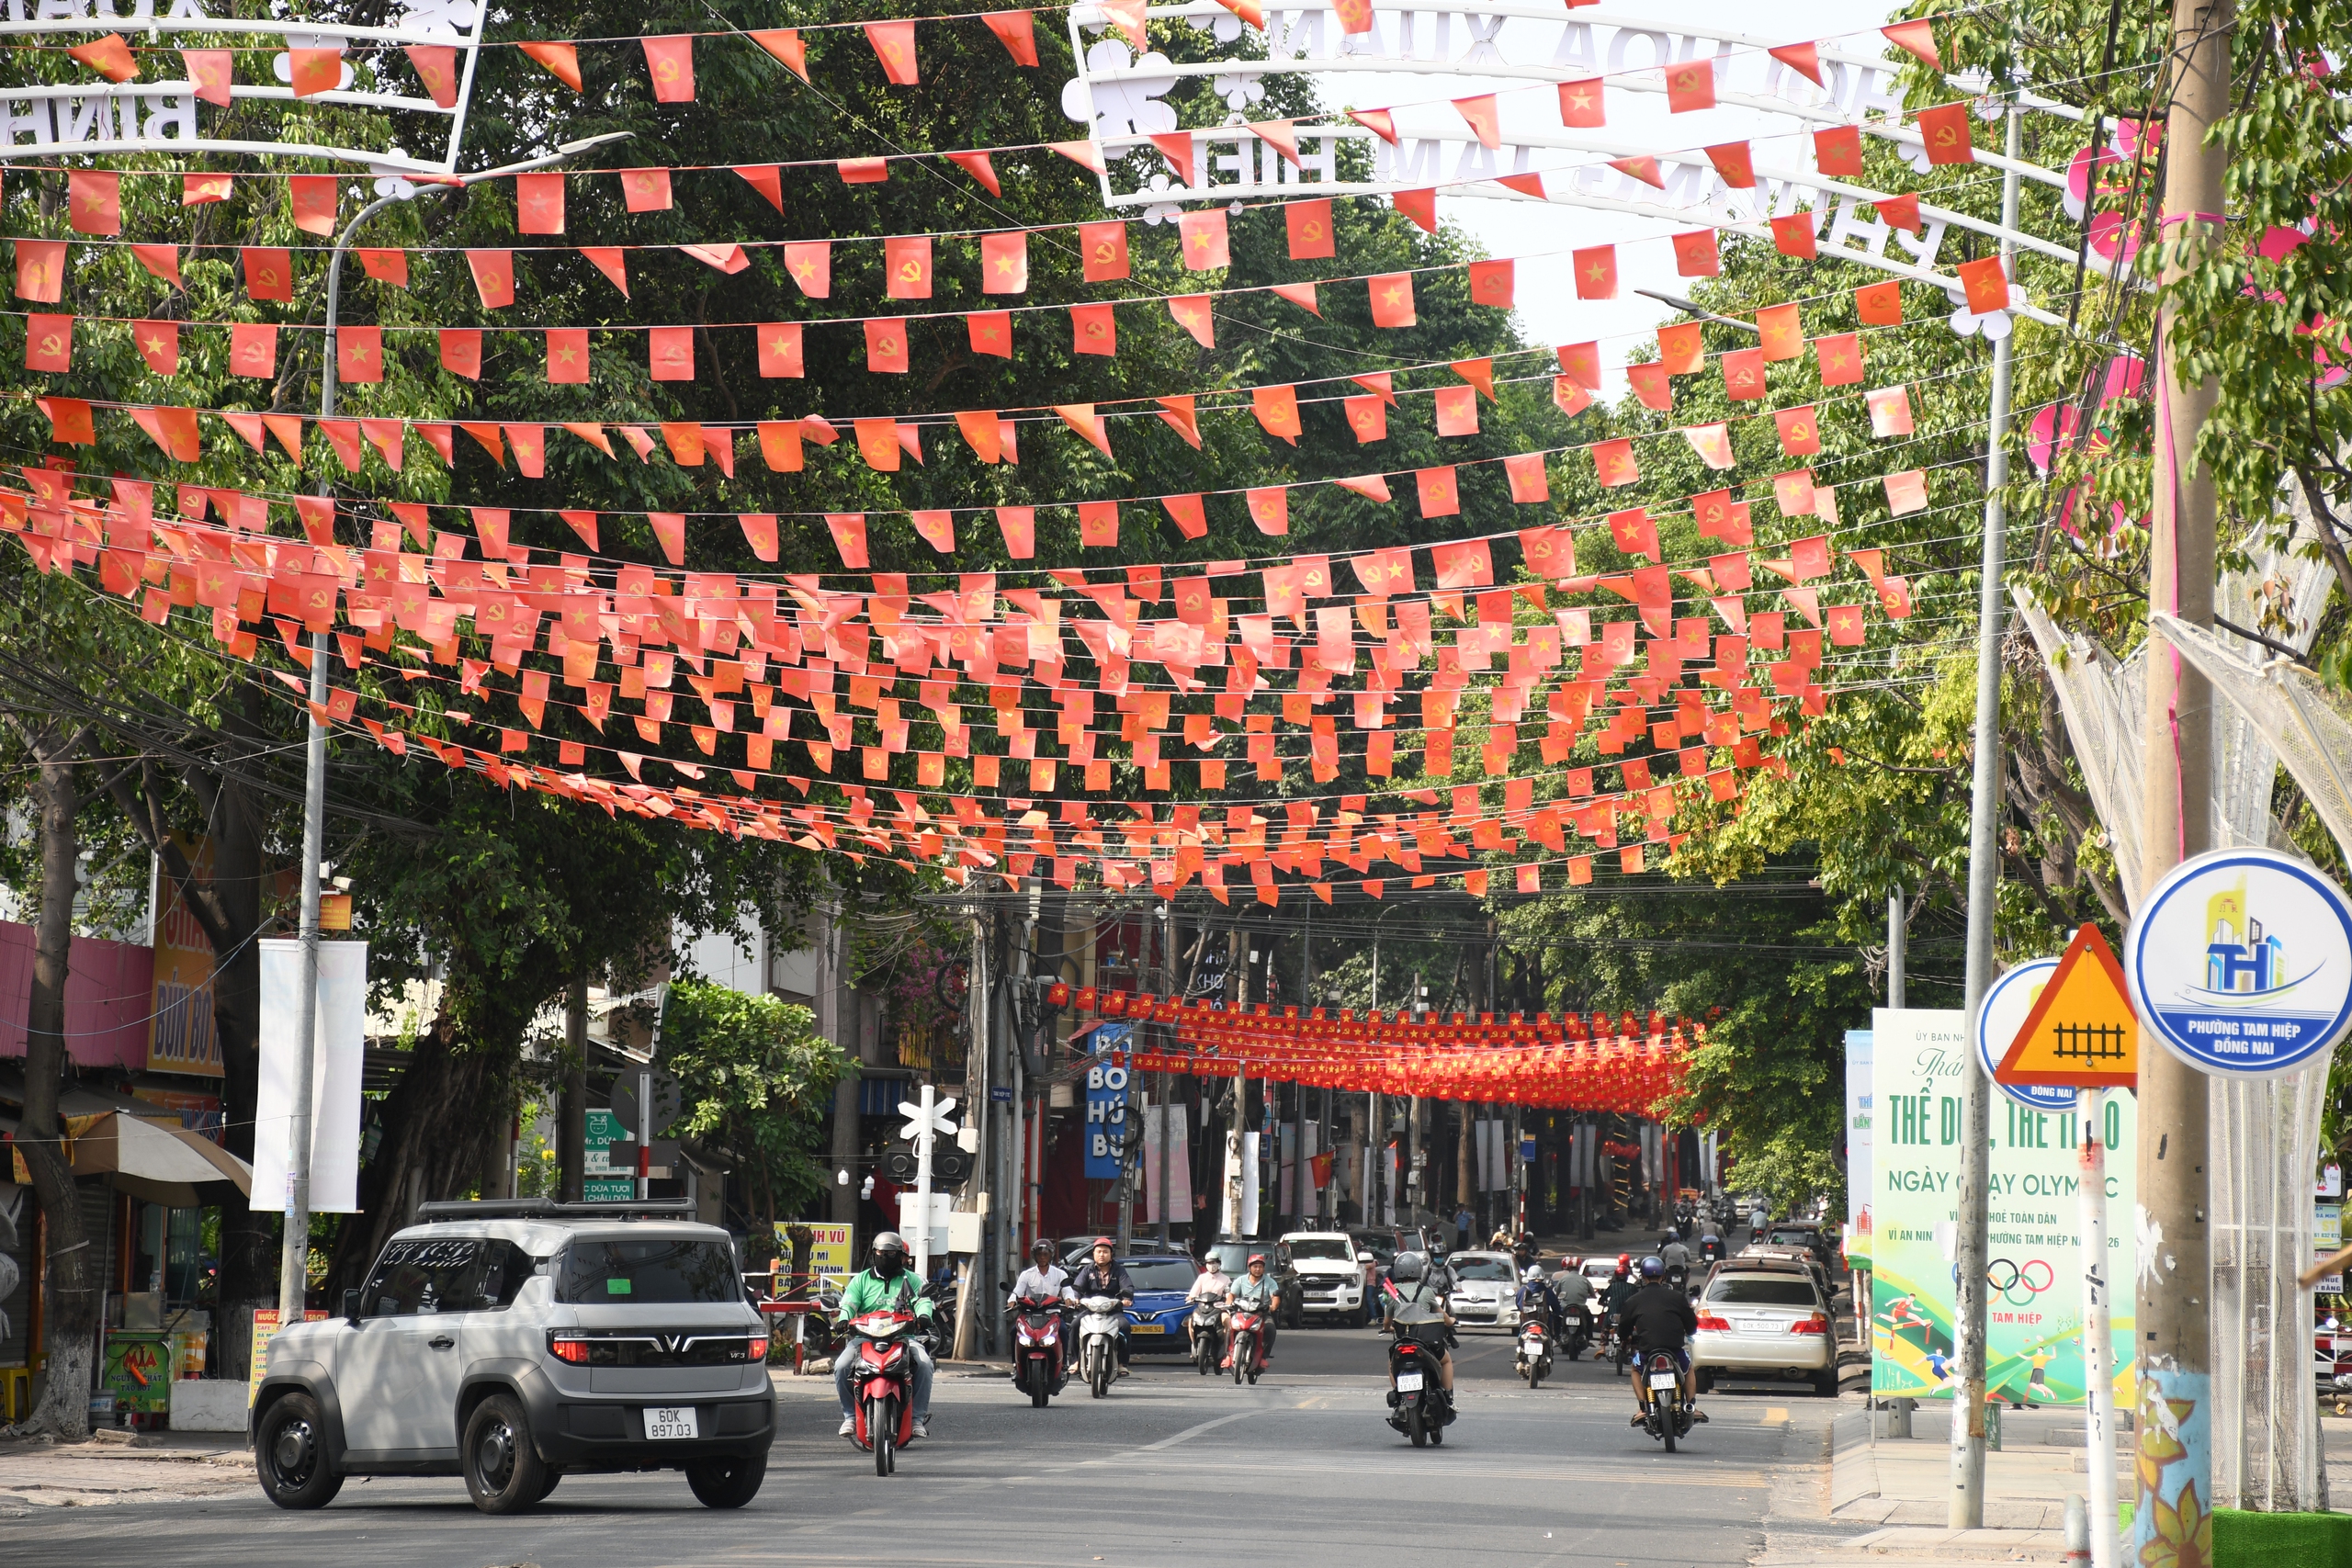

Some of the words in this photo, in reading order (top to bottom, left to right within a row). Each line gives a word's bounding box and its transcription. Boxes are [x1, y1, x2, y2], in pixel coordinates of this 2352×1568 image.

[2188, 1019, 2239, 1036] PHƯỜNG
[2243, 1023, 2268, 1037] TAM
[2272, 1021, 2301, 1040] HIỆP
[1931, 1033, 1950, 1042] BAN
[1953, 1034, 1965, 1043] NH
[2252, 1042, 2274, 1055] NAI
[1912, 1048, 1964, 1076] Thá
[2057, 1089, 2072, 1098] NAI
[1889, 1077, 1931, 1145] THỂ
[591, 1184, 609, 1192] DỪA
[1888, 1166, 1950, 1192] NGÀY
[2023, 1174, 2119, 1198] OLYMC
[1949, 1210, 1958, 1221] VÌ
[1988, 1209, 2007, 1224] HOẺ
[2010, 1211, 2035, 1224] TOÀN
[2037, 1211, 2057, 1224] DÂN
[829, 1228, 845, 1243] VŨ
[1888, 1228, 1897, 1241] VÌ
[1900, 1230, 1913, 1241] AN
[1915, 1231, 1934, 1242] NIN
[1988, 1232, 2022, 1244] HƯỜNG
[2024, 1234, 2044, 1245] TAM
[2047, 1233, 2068, 1248] HIỆP
[2107, 1236, 2120, 1248] 26
[817, 1250, 829, 1261] MÌ
[813, 1264, 843, 1274] THÁNH
[257, 1311, 276, 1321] NƯỚC
[1992, 1312, 2013, 1323] TAM
[2017, 1312, 2042, 1325] HIỆP
[659, 1410, 680, 1422] 60K
[651, 1424, 691, 1437] 897.03
